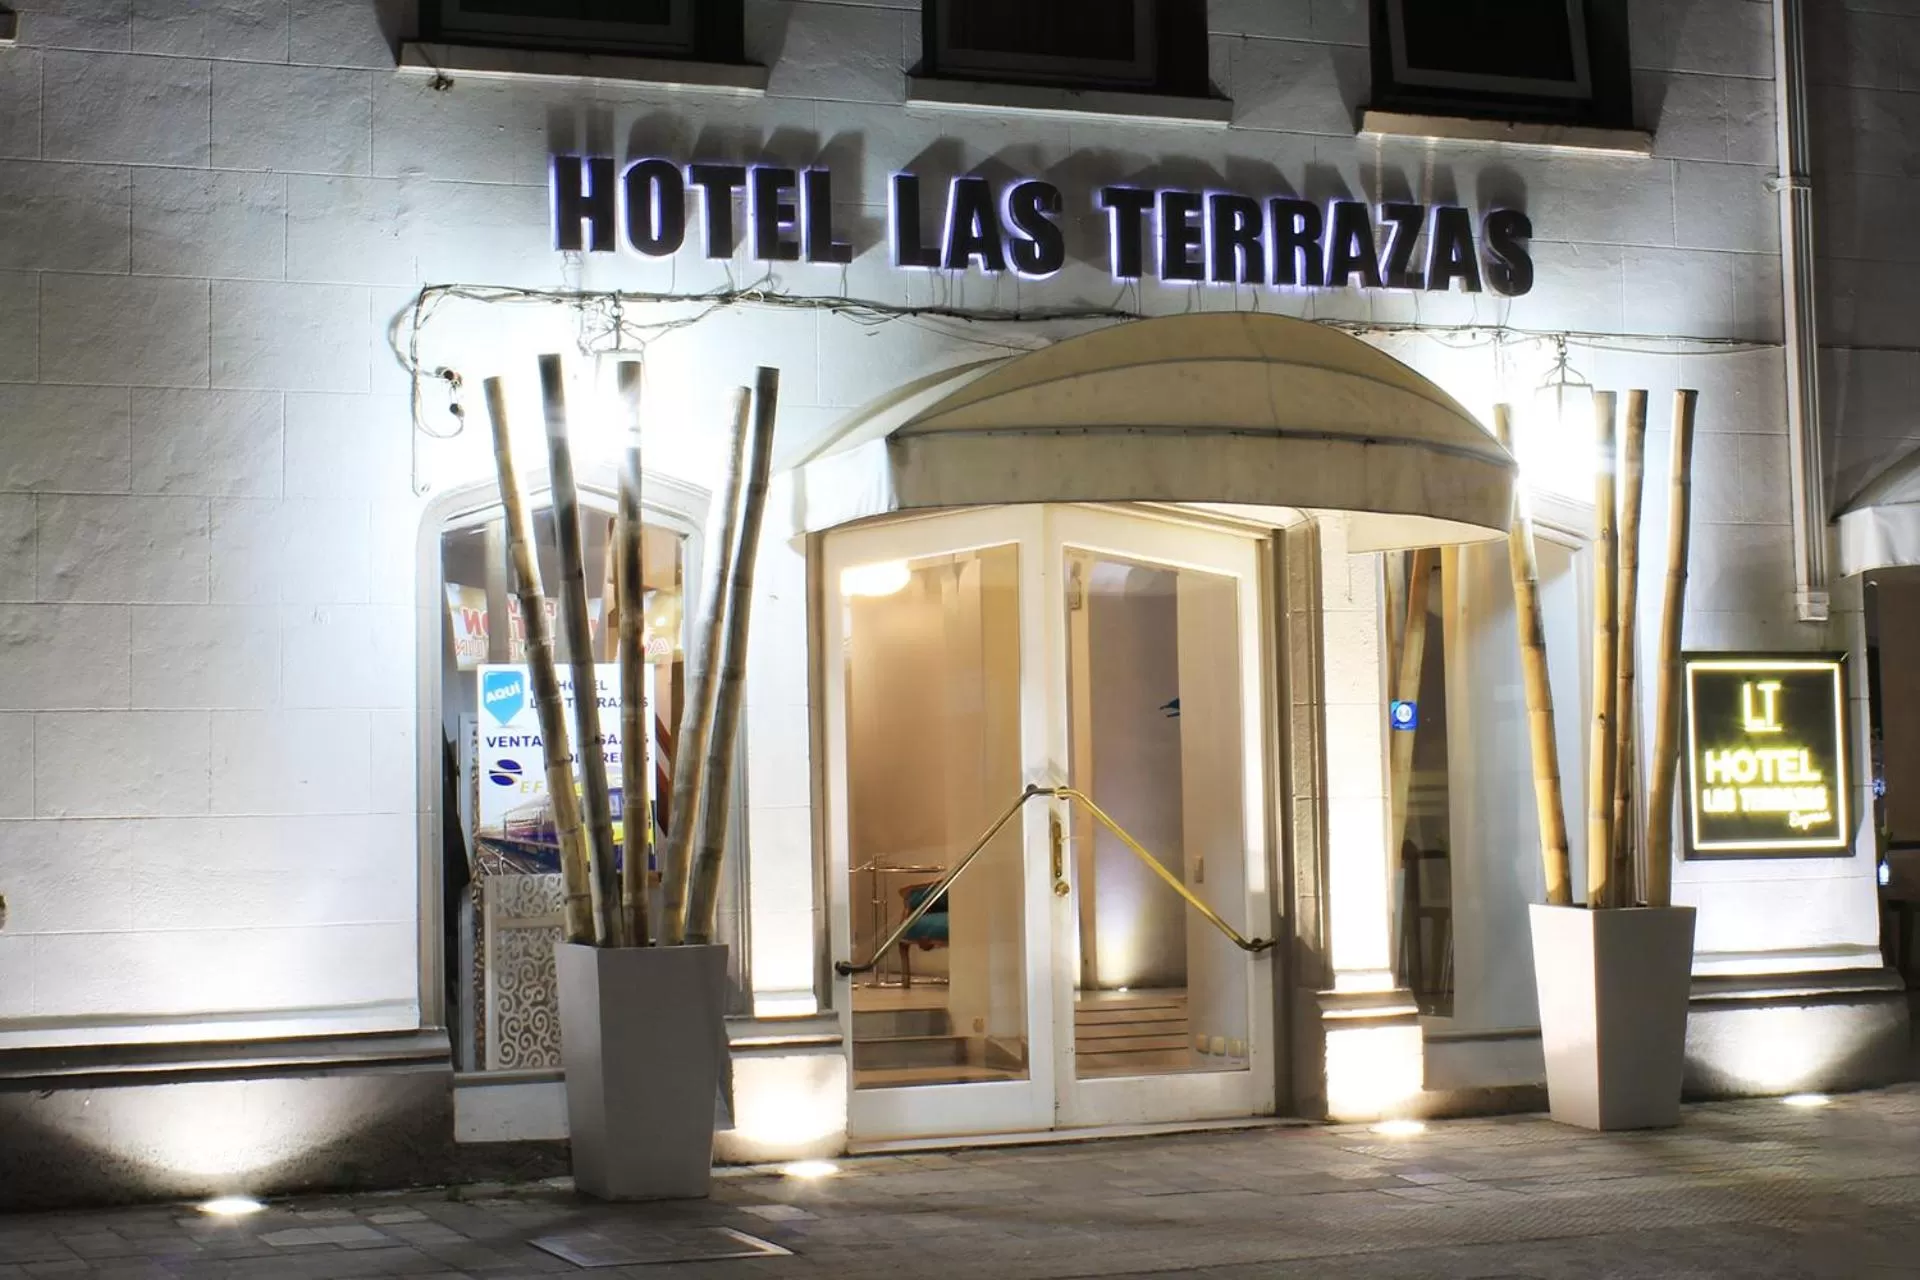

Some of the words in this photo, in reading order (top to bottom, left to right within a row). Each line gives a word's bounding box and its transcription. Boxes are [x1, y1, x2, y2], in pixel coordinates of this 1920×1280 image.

[551, 155, 853, 264] HOTEL
[891, 173, 1066, 280] LAS
[1099, 185, 1534, 297] TERRAZAS
[1742, 680, 1783, 733] LT
[486, 735, 544, 748] VENTA
[1703, 748, 1822, 784] HOTEL
